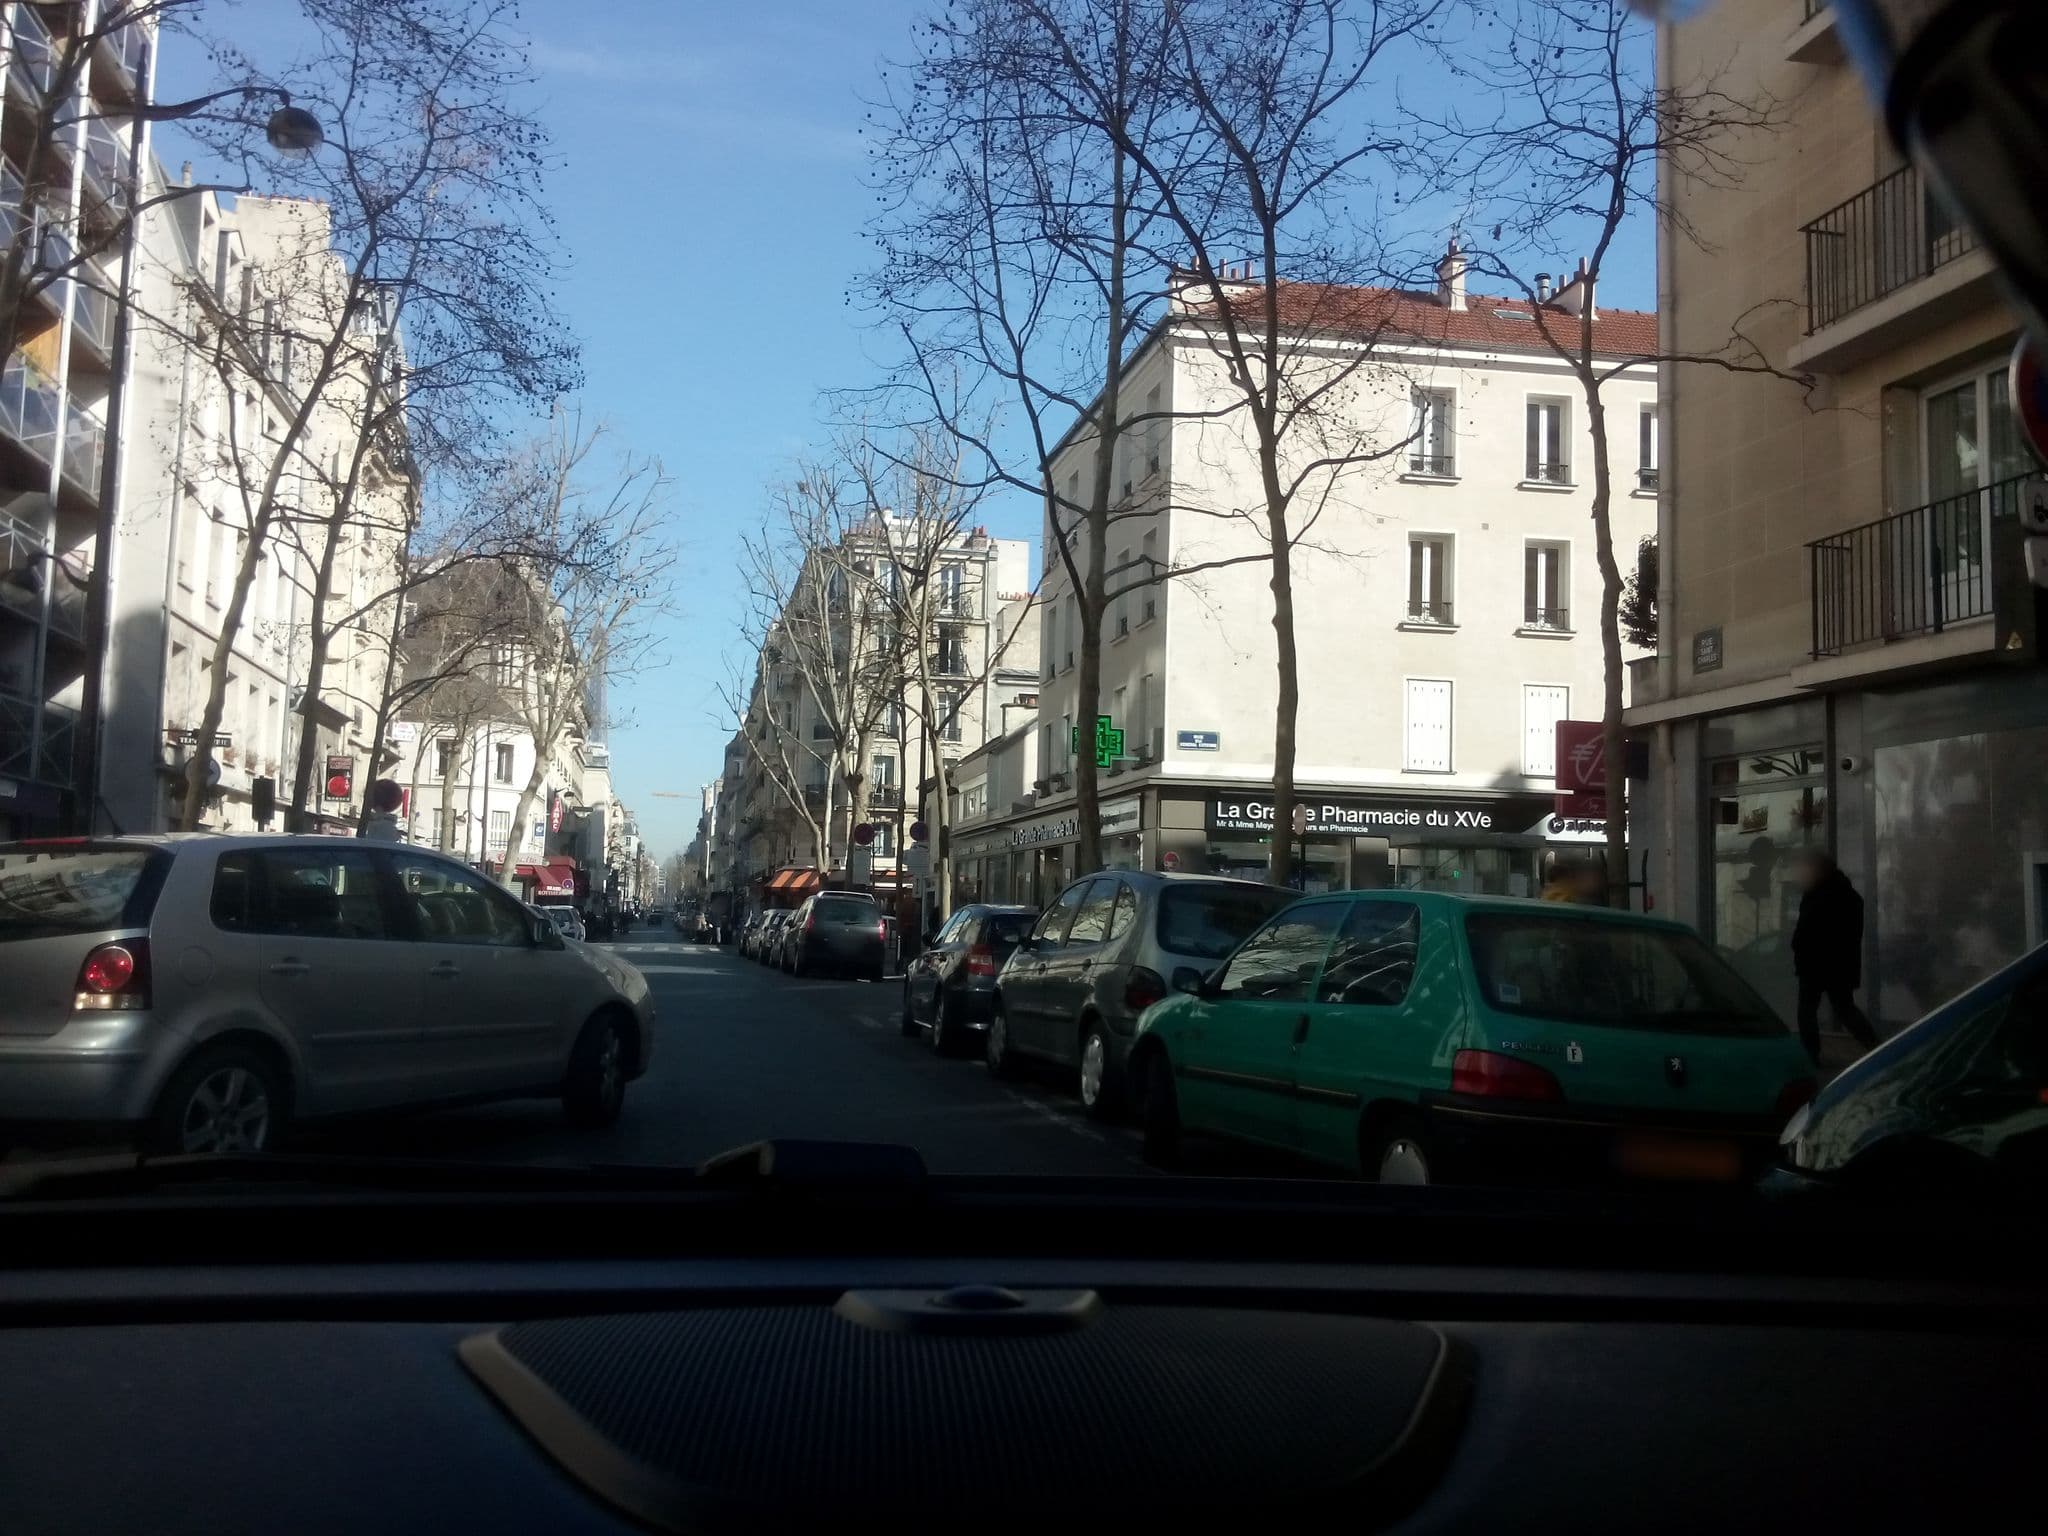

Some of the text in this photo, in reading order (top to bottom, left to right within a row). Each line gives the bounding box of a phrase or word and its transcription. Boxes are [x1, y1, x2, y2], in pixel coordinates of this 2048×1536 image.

[1217, 801, 1240, 819] La
[1322, 806, 1420, 826] Pharmacie
[1426, 810, 1449, 827] du
[1454, 811, 1492, 828] XVe
[1217, 820, 1226, 828] Mr
[1228, 821, 1234, 829] &
[1236, 821, 1254, 830] Mme
[1318, 825, 1329, 833] en
[1330, 825, 1369, 834] Pharmacie
